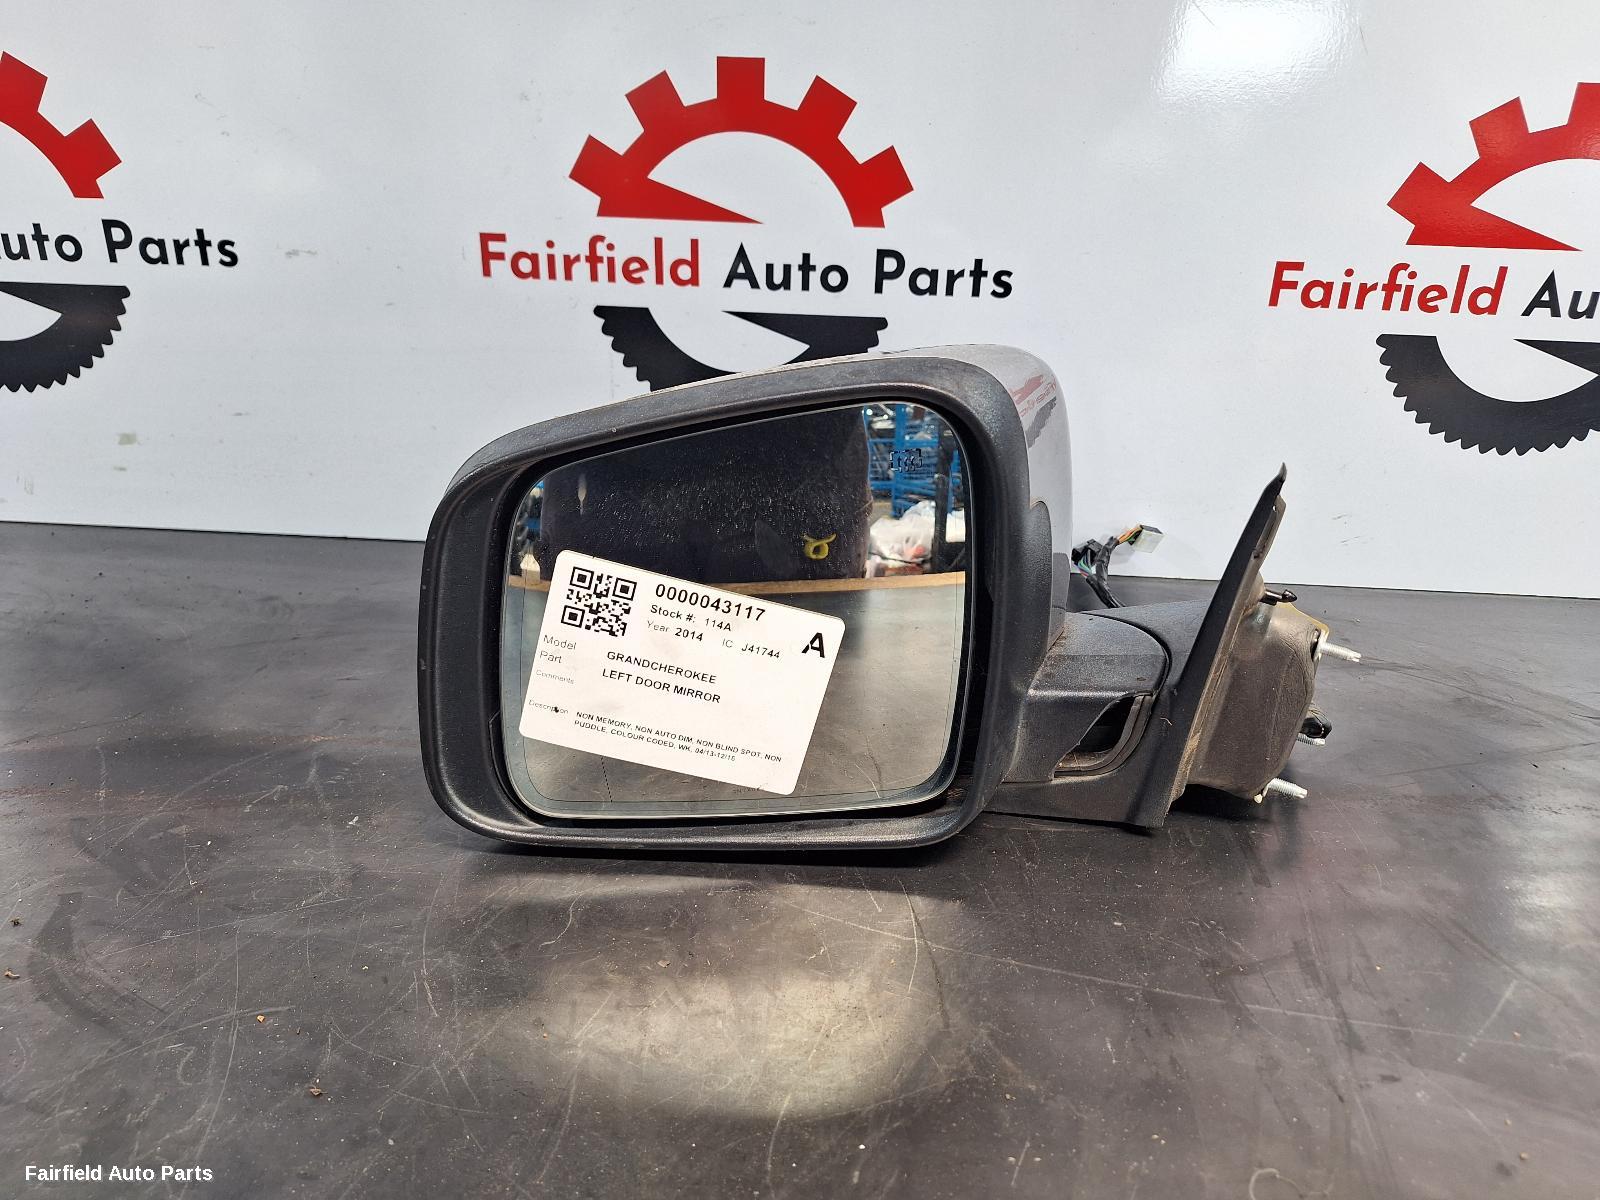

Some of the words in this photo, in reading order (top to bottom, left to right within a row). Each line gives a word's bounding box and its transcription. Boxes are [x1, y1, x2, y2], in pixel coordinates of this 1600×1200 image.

[0, 223, 82, 262] uto
[101, 219, 238, 267] Parts
[480, 233, 699, 286] Fairfield
[723, 242, 848, 293] Auto
[874, 249, 1013, 298] Parts
[1269, 261, 1508, 315] Fairfield
[655, 583, 766, 621] 0000043117
[647, 620, 669, 633] Year
[674, 627, 704, 642] 2014
[650, 604, 682, 620] Stock
[685, 613, 696, 623] #:
[705, 617, 731, 632] 114A
[539, 650, 562, 664] Part
[543, 634, 577, 650] Model
[801, 632, 826, 659] A
[607, 651, 716, 684] GRANDCHEROKEE
[602, 668, 633, 683] LEFT
[635, 676, 671, 692] DOOR
[673, 685, 721, 704] MIRROR
[528, 699, 569, 714] Descripon
[576, 711, 595, 721] NON
[634, 725, 653, 734] NON
[654, 729, 677, 740] AUTO
[696, 738, 714, 748] NON
[715, 742, 739, 754] BLIND
[764, 753, 782, 763] NON
[610, 728, 645, 741] COLOUR
